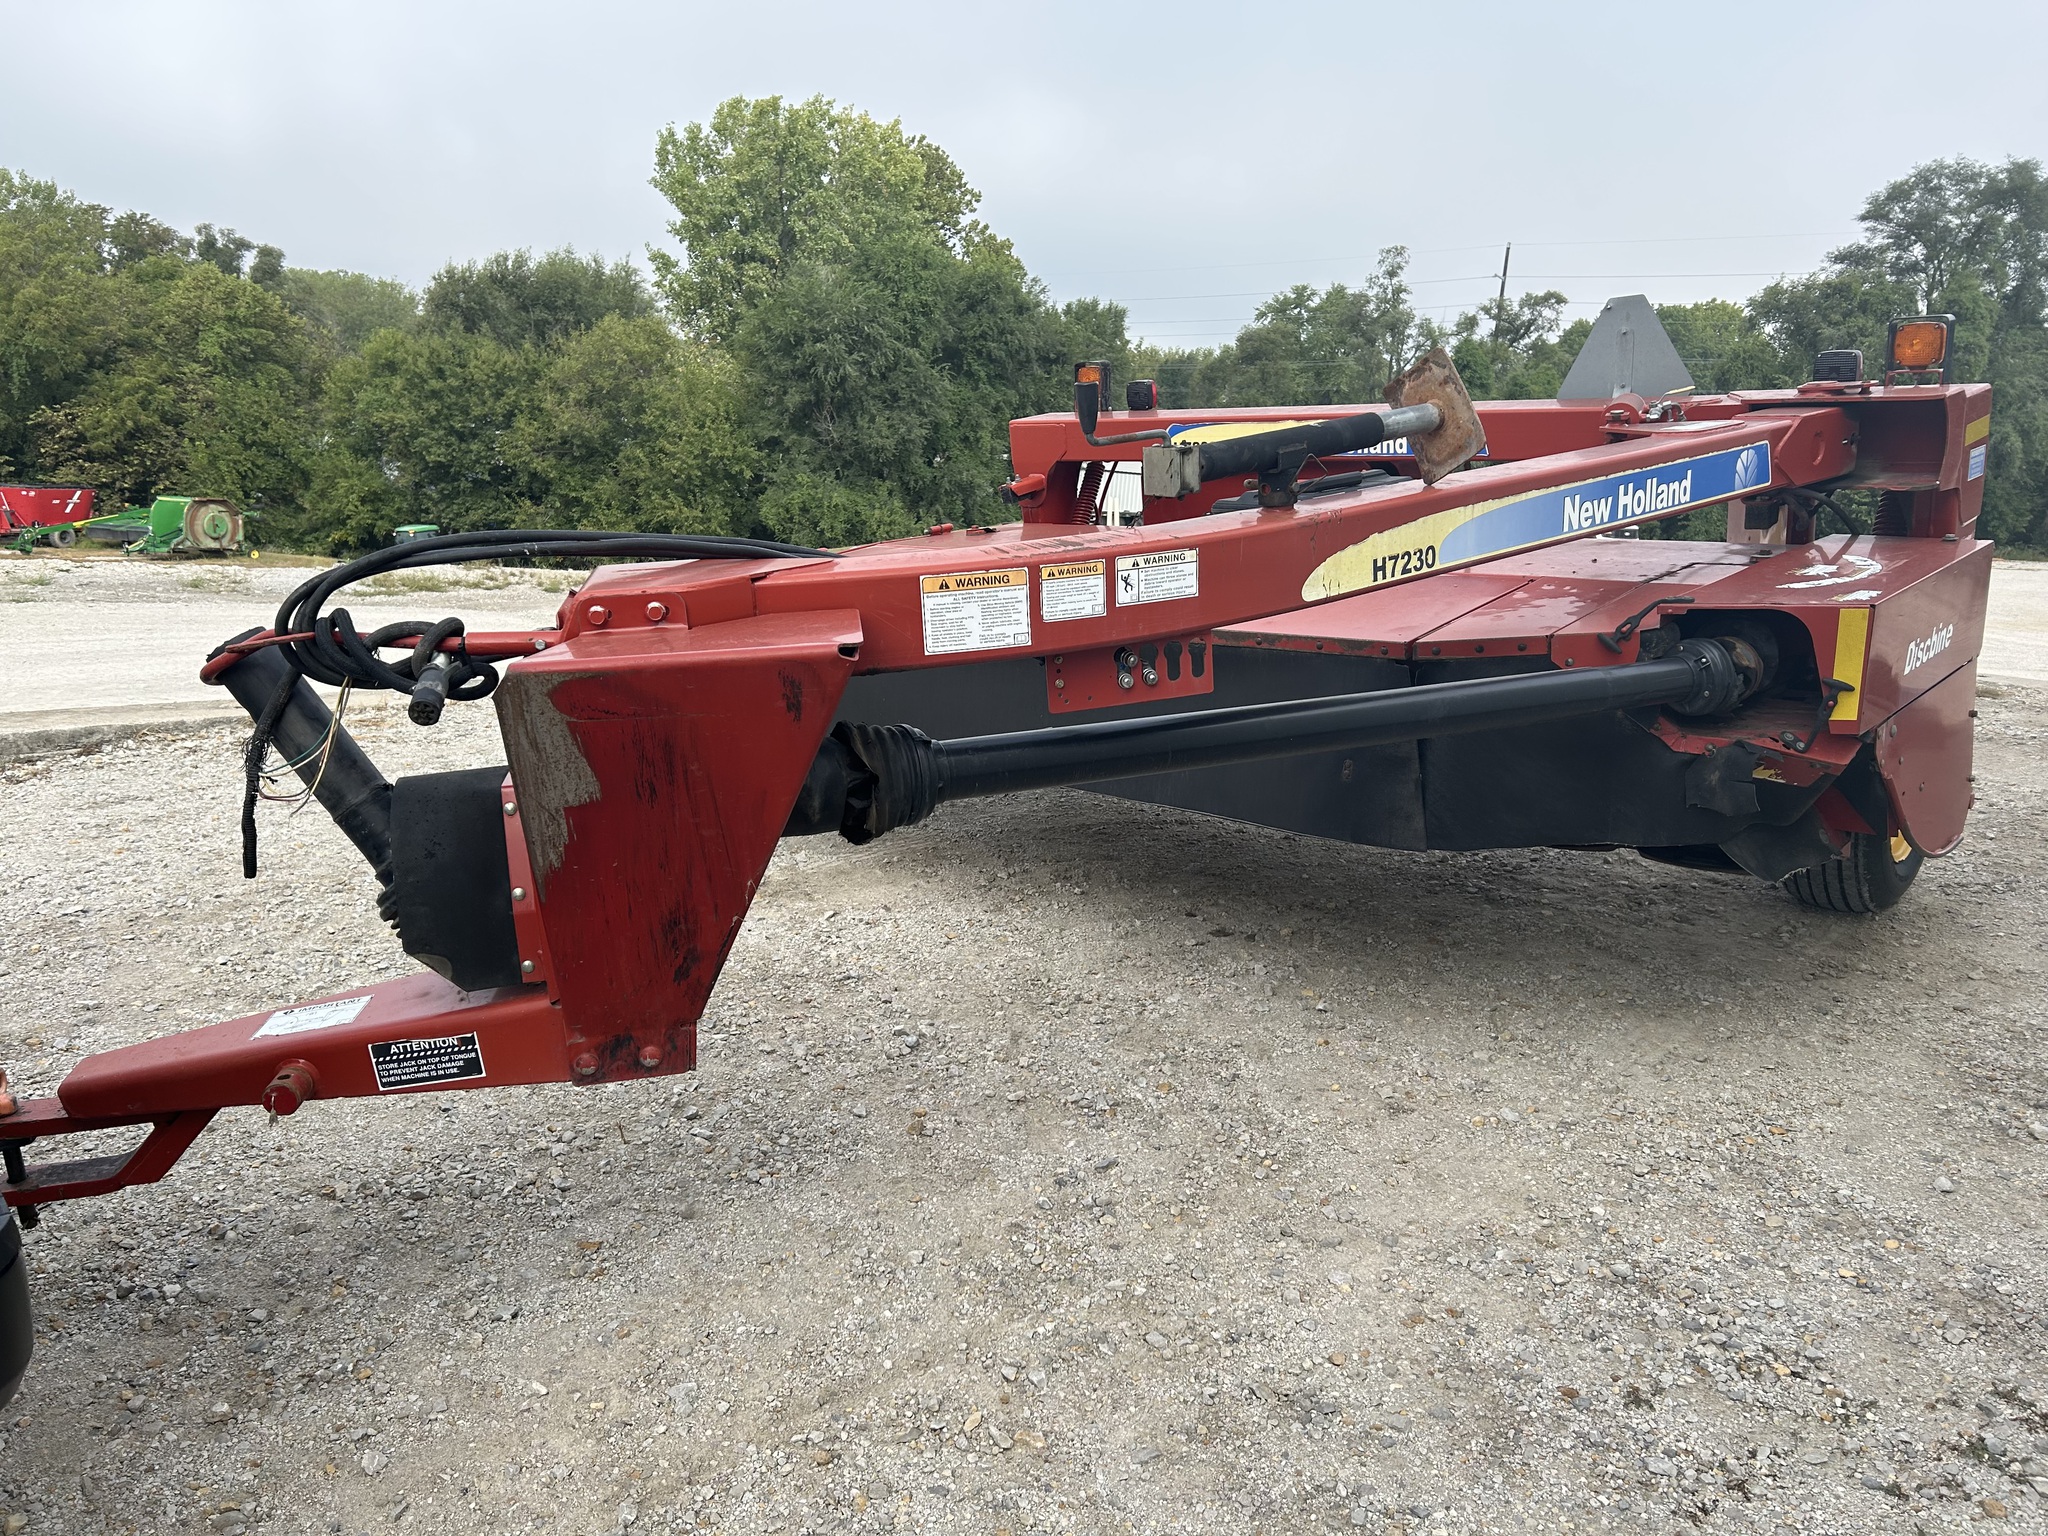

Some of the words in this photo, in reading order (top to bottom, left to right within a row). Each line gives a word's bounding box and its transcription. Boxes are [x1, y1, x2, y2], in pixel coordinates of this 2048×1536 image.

[1563, 494, 1613, 532] New
[1617, 469, 1692, 519] Holland
[1143, 552, 1185, 565] WARNING
[1372, 545, 1436, 582] H7230
[1057, 565, 1097, 575] WARNING
[955, 574, 1009, 588] WARNING
[1903, 622, 1954, 676] Discbine
[388, 1037, 458, 1054] ATTENTION
[377, 1062, 399, 1070] STORE
[398, 1059, 416, 1067] JACK
[450, 1052, 476, 1060] TONGUE
[388, 1066, 418, 1075] PREVENT
[436, 1060, 464, 1068] DAMAGE
[400, 1071, 429, 1080] MACHINE
